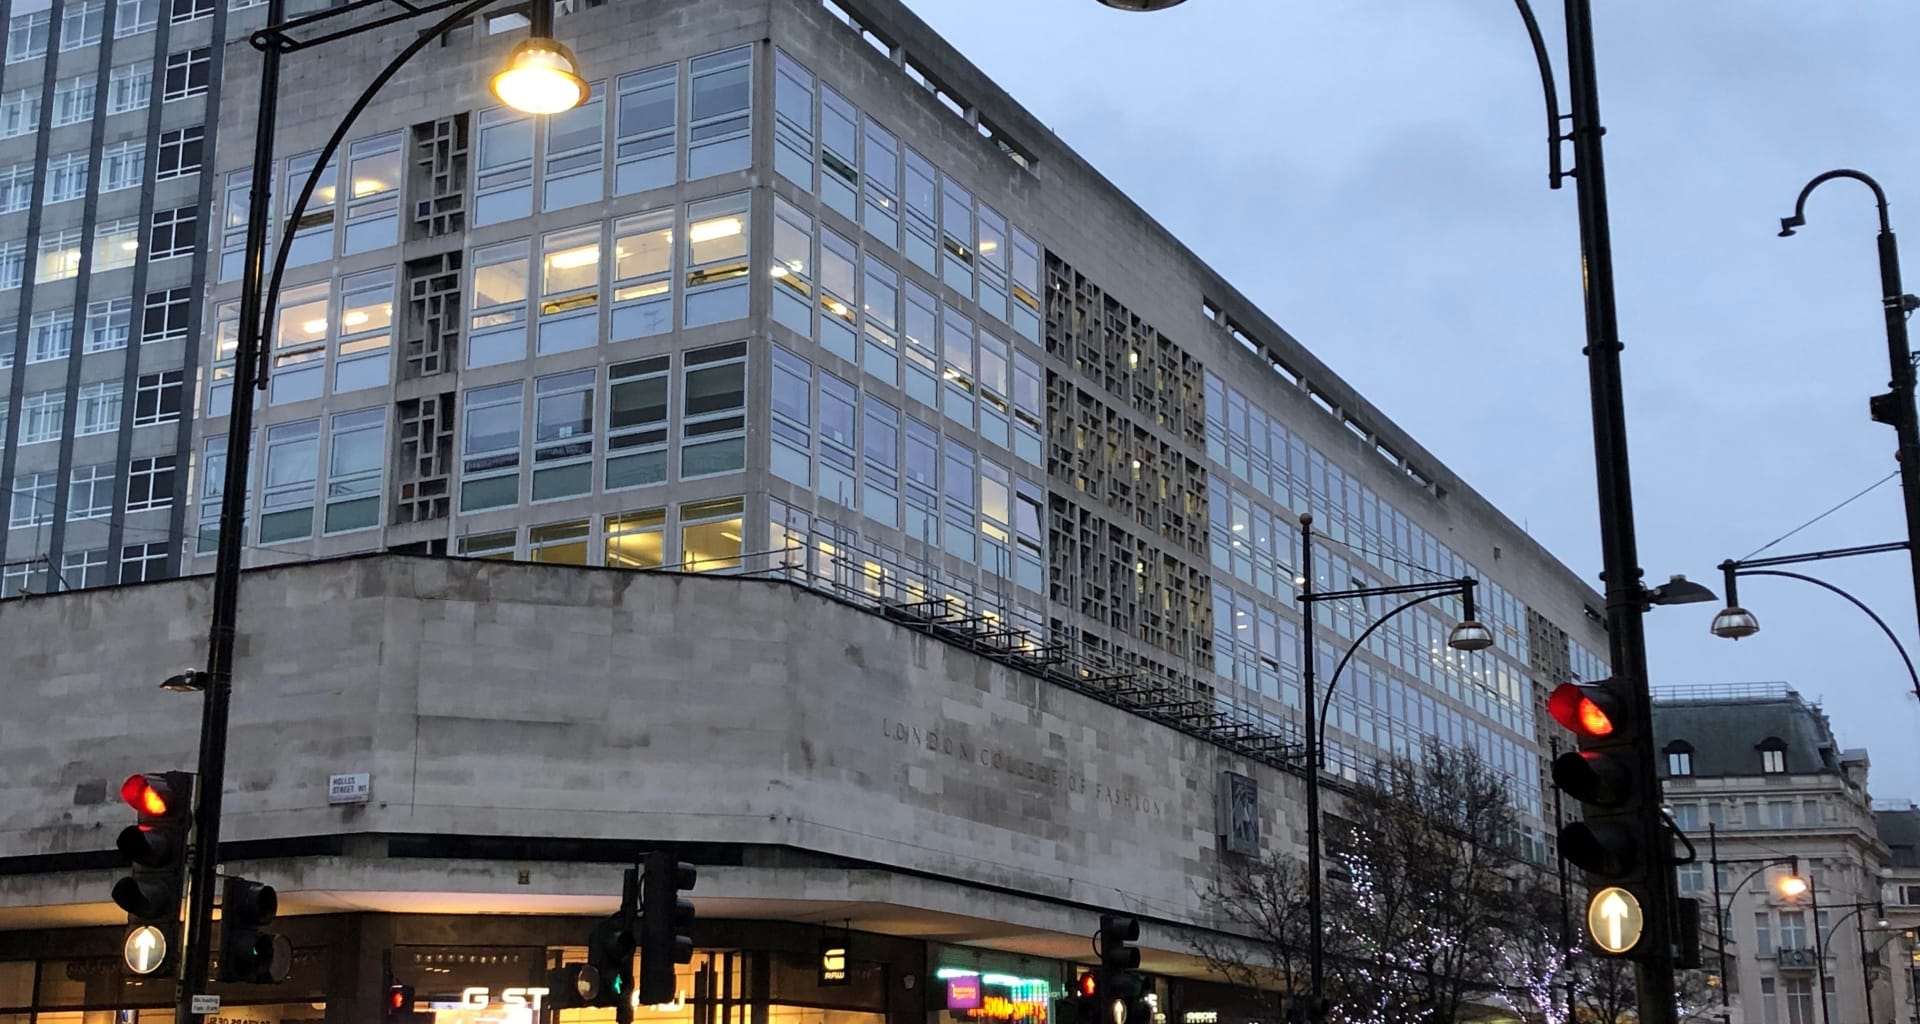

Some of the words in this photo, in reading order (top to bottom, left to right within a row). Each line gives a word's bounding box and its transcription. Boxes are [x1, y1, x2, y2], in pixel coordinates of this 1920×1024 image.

[883, 718, 970, 760] LONDON
[980, 749, 1058, 786] COLLEGE
[1068, 775, 1086, 795] OF
[1096, 783, 1161, 817] FASHION
[333, 776, 356, 785] HOLLES
[332, 785, 354, 794] STREET
